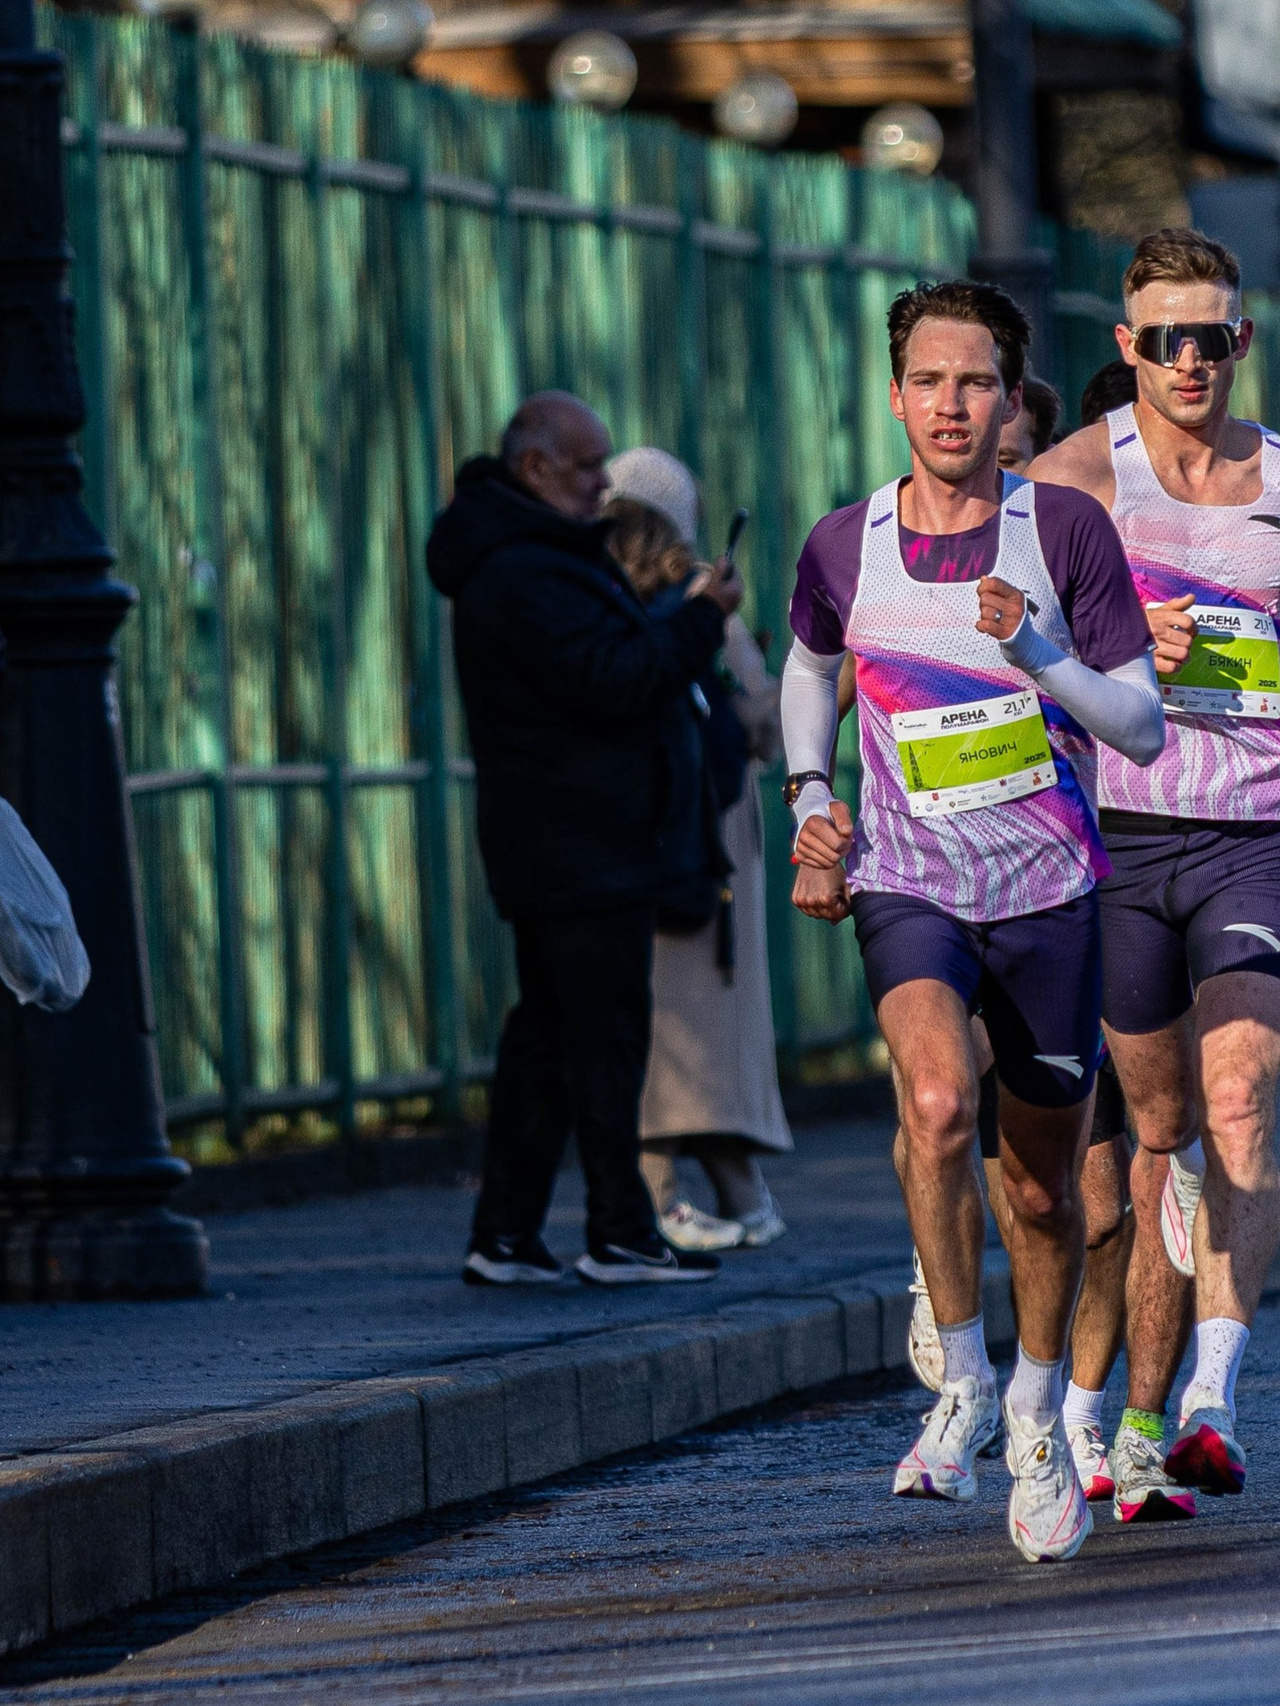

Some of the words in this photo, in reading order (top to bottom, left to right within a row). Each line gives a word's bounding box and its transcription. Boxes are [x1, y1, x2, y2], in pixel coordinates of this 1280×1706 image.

[1197, 614, 1241, 626] АРЕНА
[1209, 656, 1252, 668] БЯКИН
[1258, 679, 1278, 688] 2025
[1003, 699, 1026, 714] 21,1
[941, 709, 987, 725] АРЕНА
[959, 742, 1018, 764] ЯНОВИЧ
[1024, 752, 1047, 764] 2025
